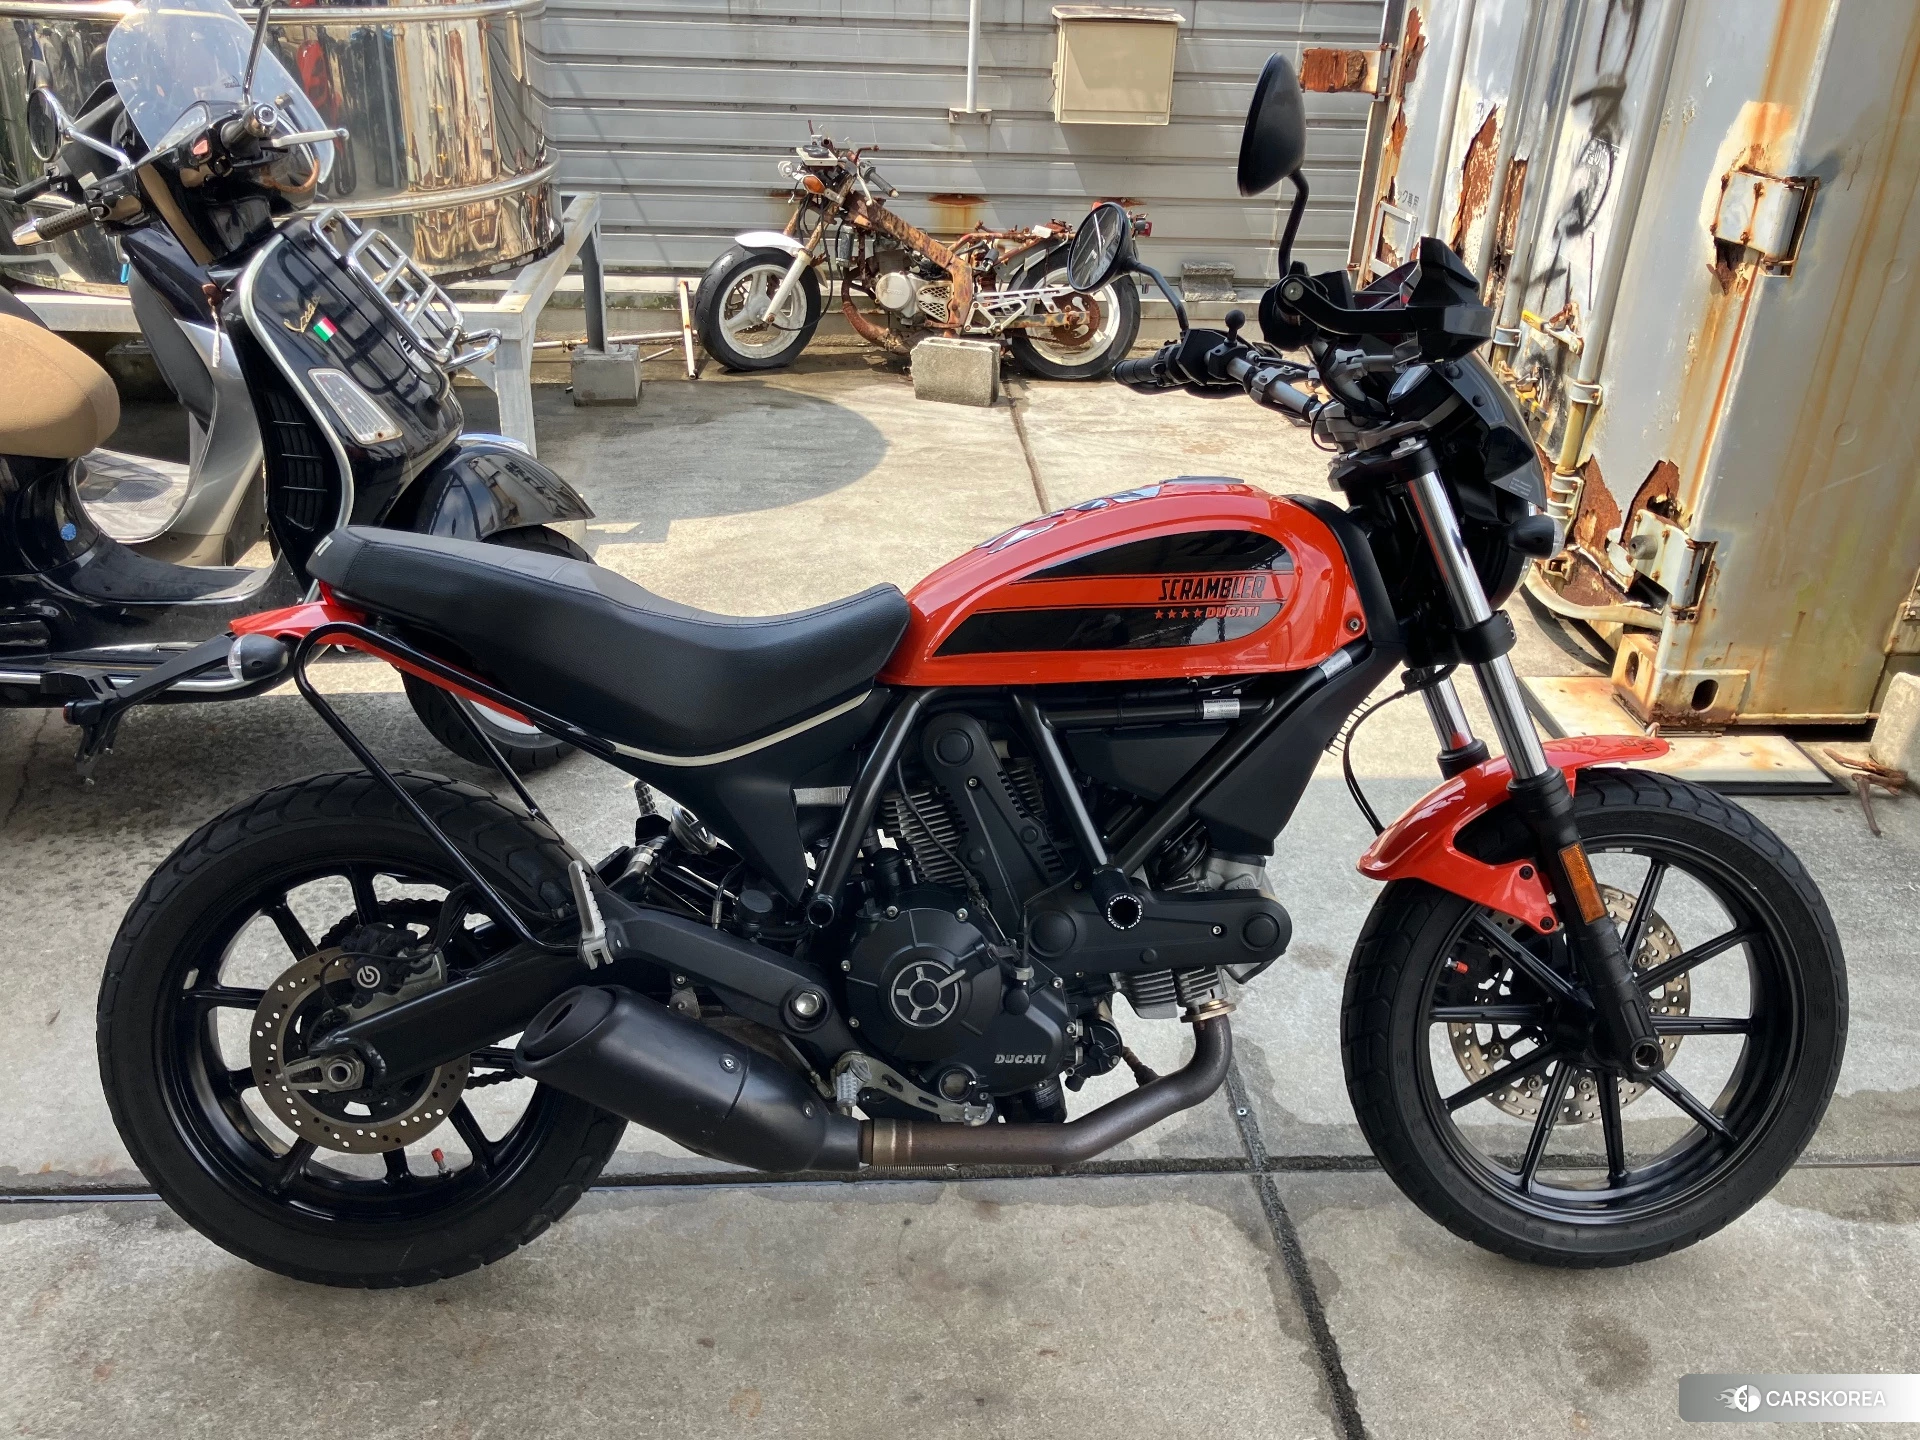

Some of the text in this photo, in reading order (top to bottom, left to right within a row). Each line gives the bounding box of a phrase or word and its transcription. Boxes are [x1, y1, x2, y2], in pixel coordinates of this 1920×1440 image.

[1158, 576, 1266, 600] SCRAMBLER
[1205, 606, 1260, 618] DUCATI
[994, 1054, 1047, 1064] DUCATI
